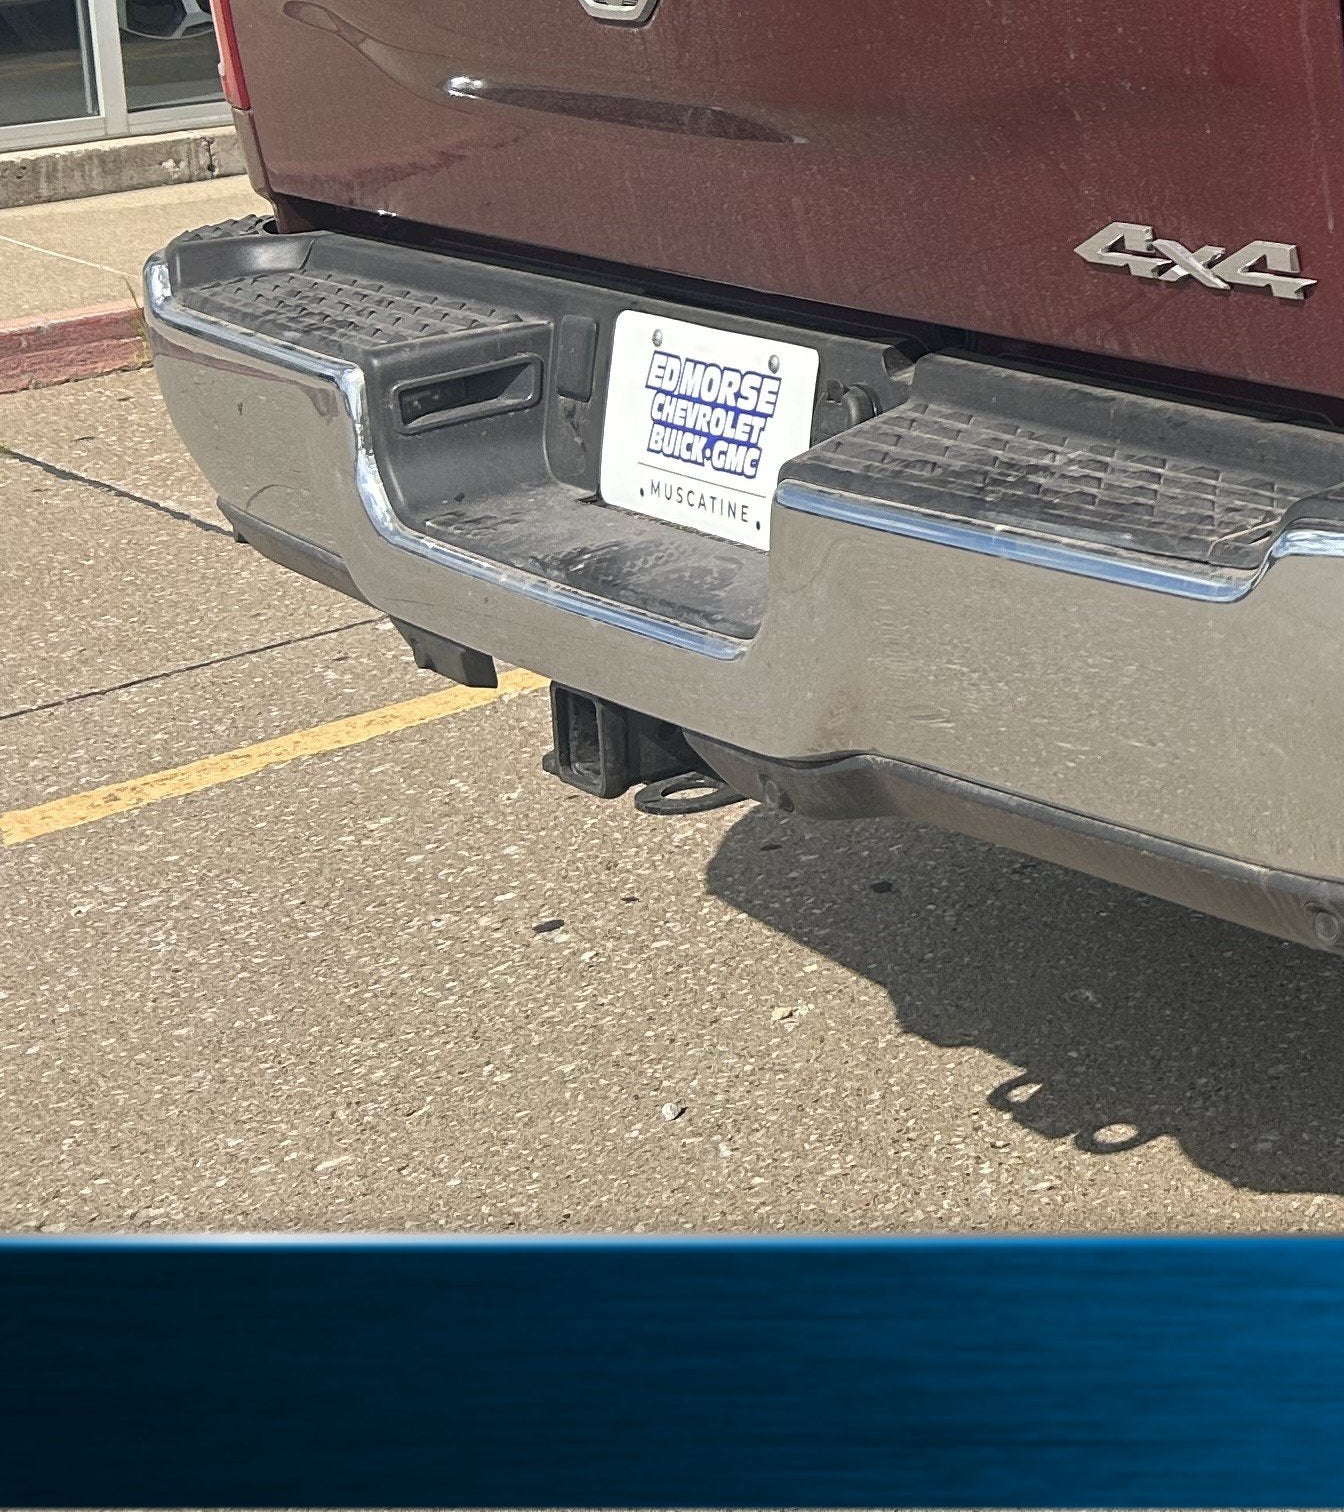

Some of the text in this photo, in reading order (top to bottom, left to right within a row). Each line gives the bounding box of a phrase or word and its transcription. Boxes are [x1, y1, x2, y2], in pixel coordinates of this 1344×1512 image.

[645, 350, 782, 418] ED MORSE
[650, 390, 769, 445] CHEVROLET
[650, 478, 749, 523] MUSCATINE
